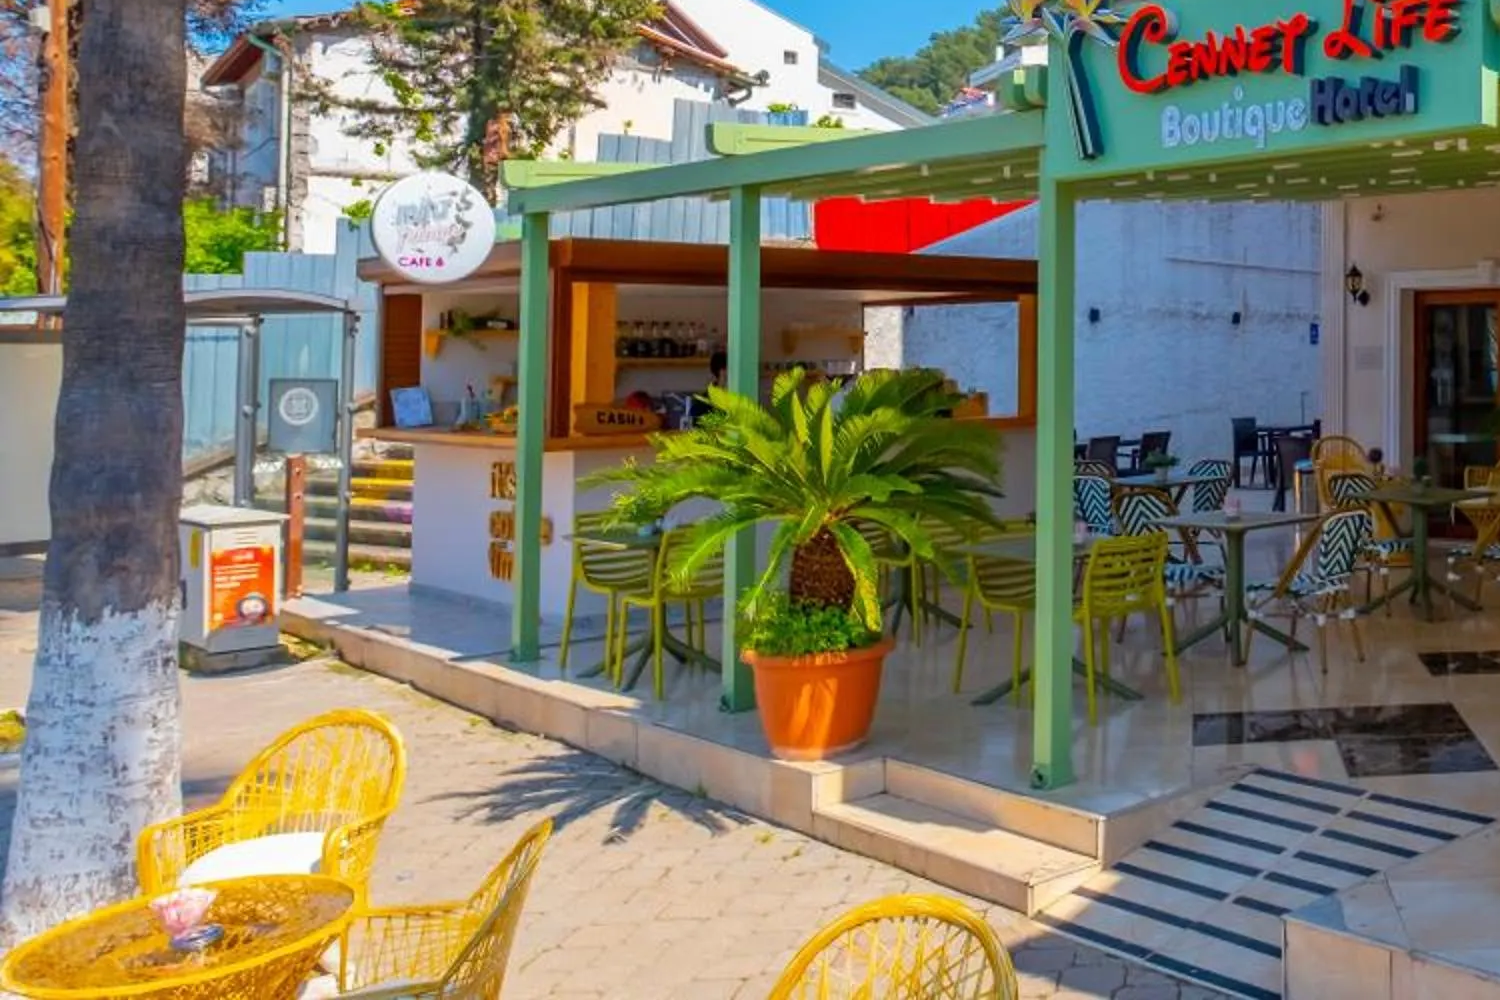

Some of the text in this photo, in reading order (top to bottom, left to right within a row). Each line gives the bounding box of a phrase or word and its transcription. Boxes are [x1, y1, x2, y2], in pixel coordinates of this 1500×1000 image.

[1117, 3, 1312, 94] CENNET
[1161, 65, 1419, 149] Boutique Hotel
